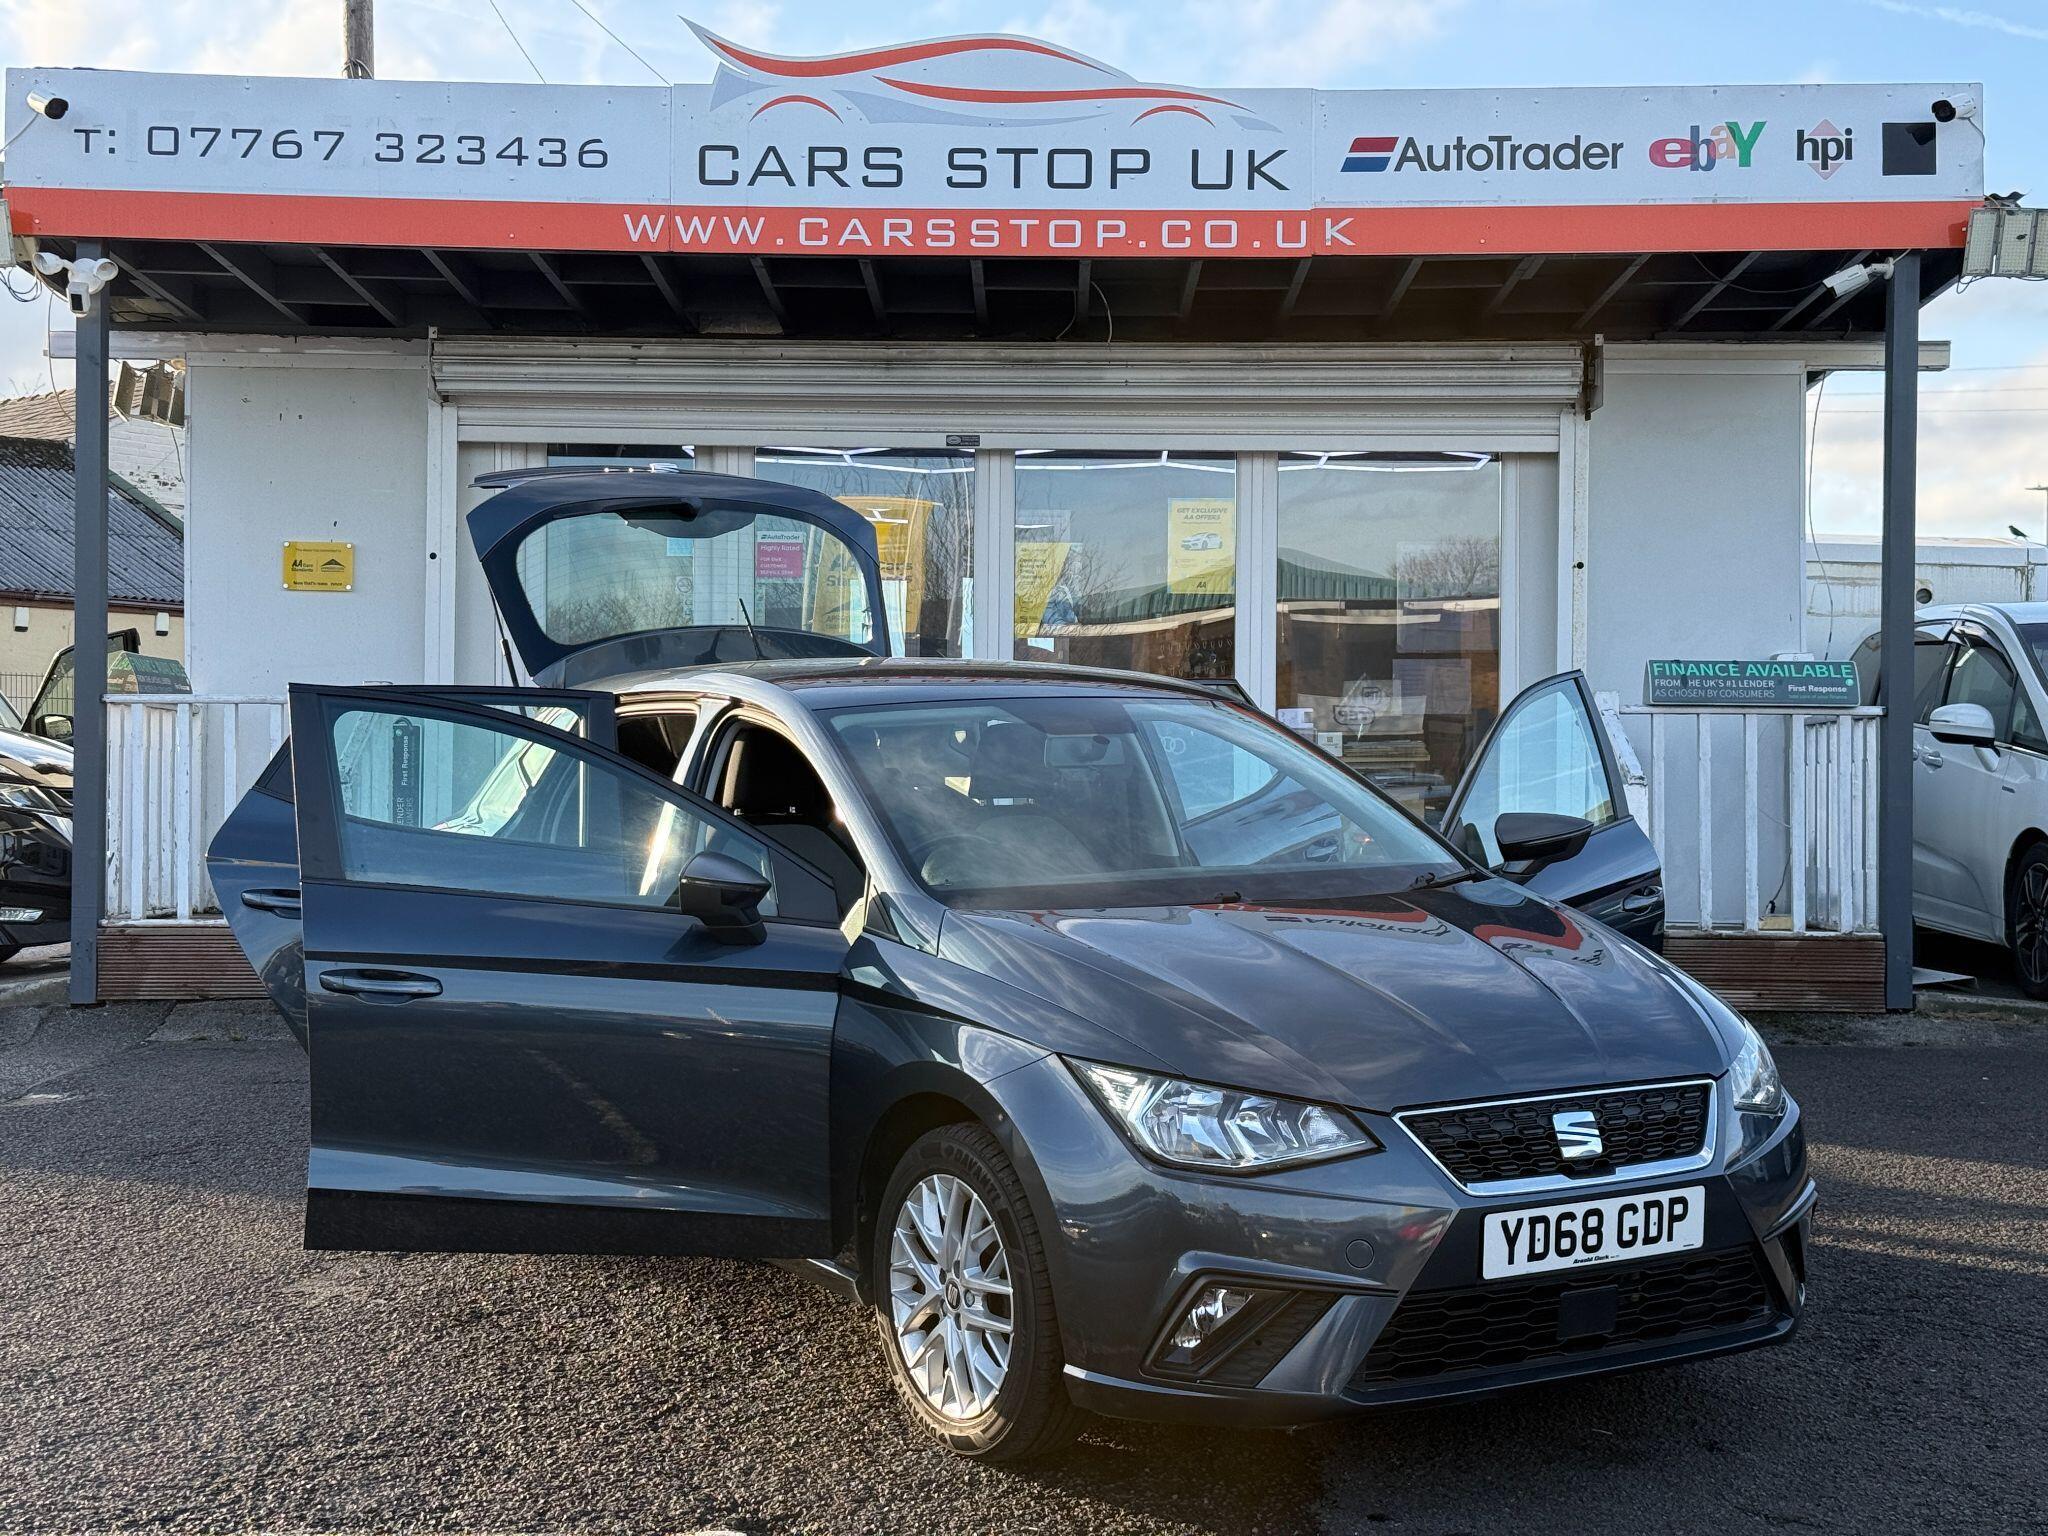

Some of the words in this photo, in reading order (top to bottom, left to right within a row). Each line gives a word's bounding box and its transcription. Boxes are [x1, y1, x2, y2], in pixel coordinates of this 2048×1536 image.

[73, 128, 118, 155] T:
[146, 125, 346, 162] 07767
[374, 131, 610, 169] 323436
[1394, 135, 1625, 173] AutoTrader
[1796, 128, 1853, 177] hpi
[697, 143, 905, 189] CARS
[945, 146, 1151, 191] STOP
[1190, 148, 1290, 192] UK
[622, 213, 1357, 250] WWW.CARSSTOP.CO.UK
[760, 544, 780, 552] Highly
[767, 533, 800, 541] AutoTrader
[292, 559, 302, 567] AA
[1652, 662, 1741, 677] FINANCE
[1745, 664, 1854, 679] AVAILABLE
[1654, 679, 1681, 688] FROM
[1683, 679, 1701, 688] HE
[1703, 679, 1725, 688] UK'S
[1738, 679, 1775, 688] LENDER
[1654, 688, 1667, 697] AS
[1667, 688, 1705, 698] CHOSEN
[1706, 689, 1718, 698] BY
[1719, 689, 1775, 698] CONSUMERS
[1787, 684, 1806, 692] First
[1808, 685, 1848, 694] Response
[402, 736, 410, 769] Response
[401, 770, 409, 786] First
[396, 797, 405, 825] ENDER
[1500, 1207, 1605, 1266] YD68
[1616, 1195, 1690, 1250] GDP
